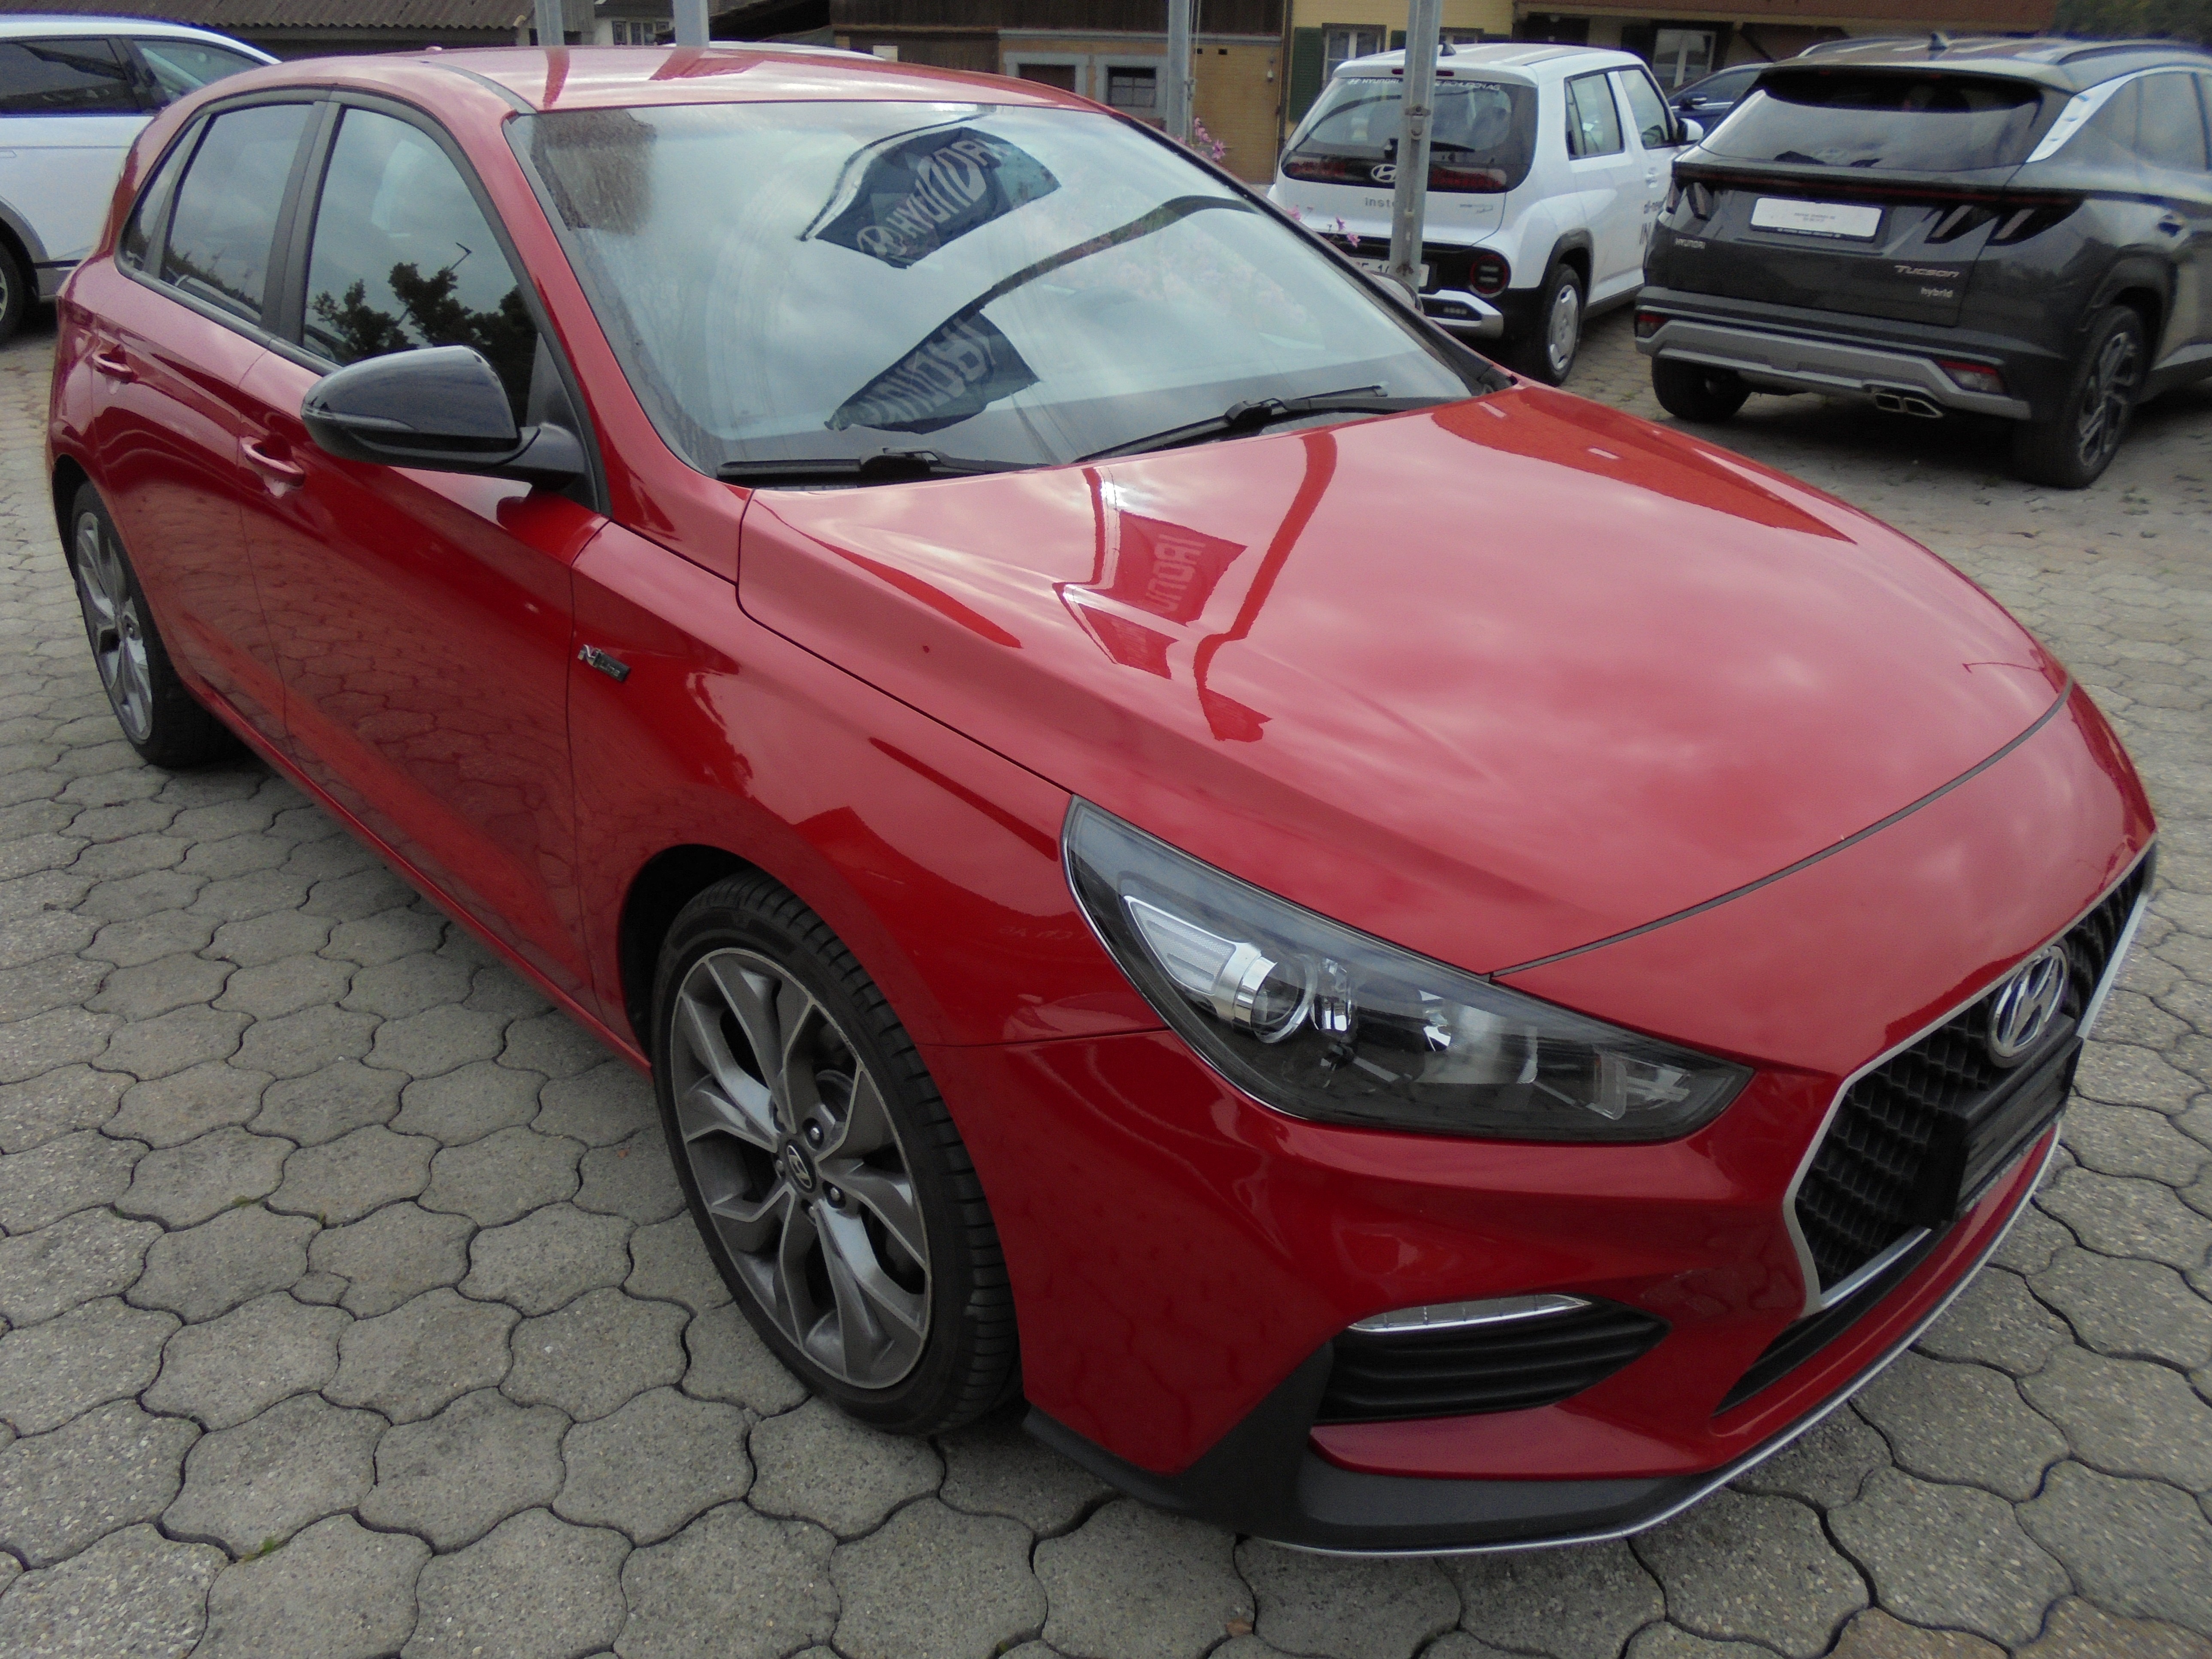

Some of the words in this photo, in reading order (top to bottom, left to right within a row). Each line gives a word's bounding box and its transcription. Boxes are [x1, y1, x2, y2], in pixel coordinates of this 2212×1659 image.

[886, 138, 1009, 239] HYUNDAI
[1365, 197, 1395, 207] inst
[1920, 286, 1954, 298] hybrid
